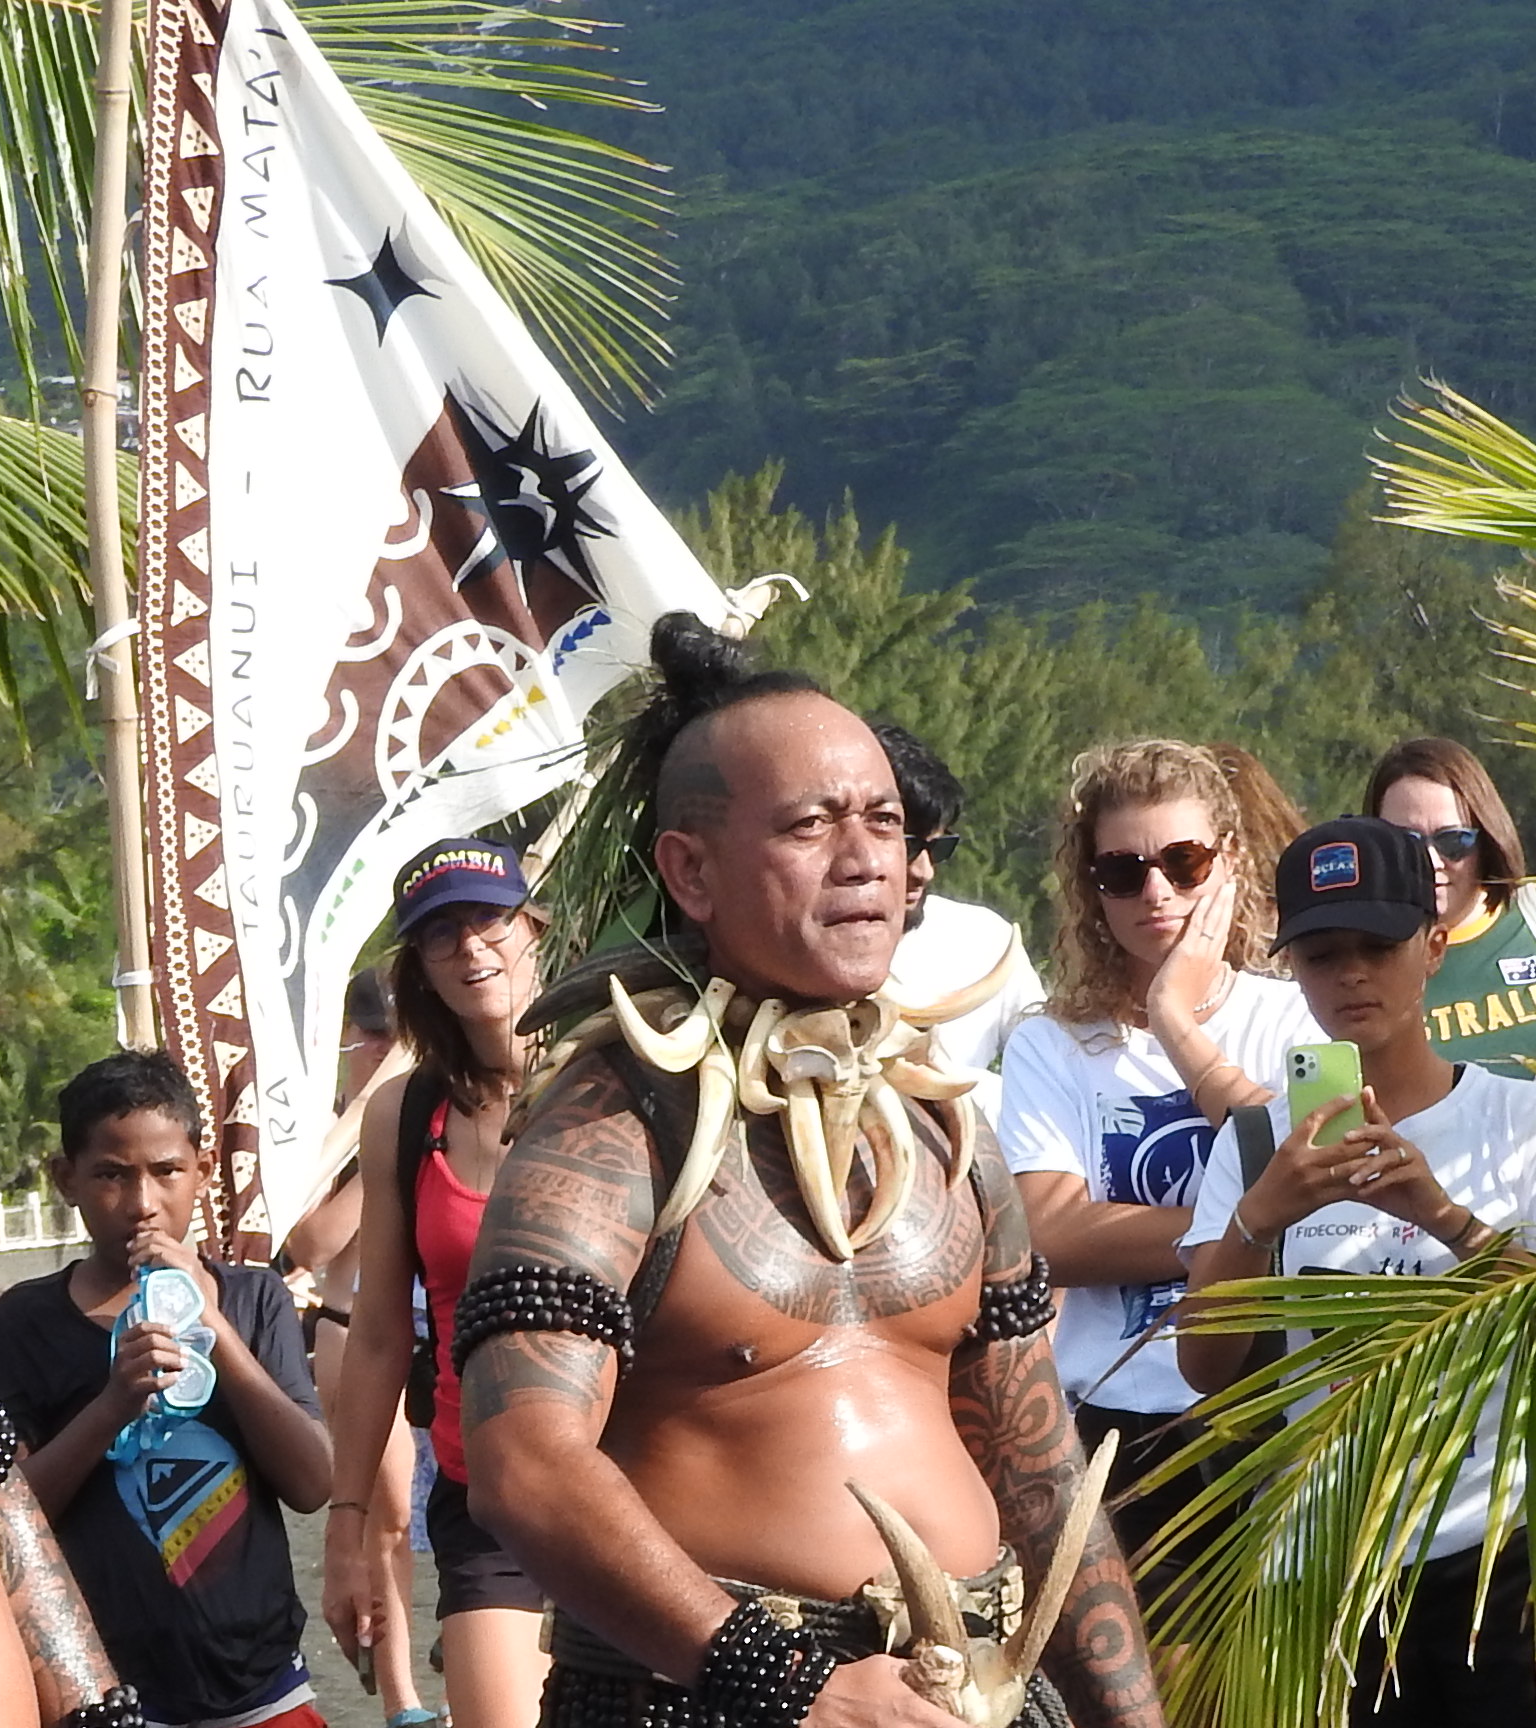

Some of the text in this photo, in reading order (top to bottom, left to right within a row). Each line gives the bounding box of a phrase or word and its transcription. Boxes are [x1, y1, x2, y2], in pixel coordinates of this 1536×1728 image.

[237, 275, 275, 403] RUA
[231, 561, 261, 938] TAURUANUI
[402, 849, 507, 899] COLOMBIA
[265, 1076, 298, 1146] RA
